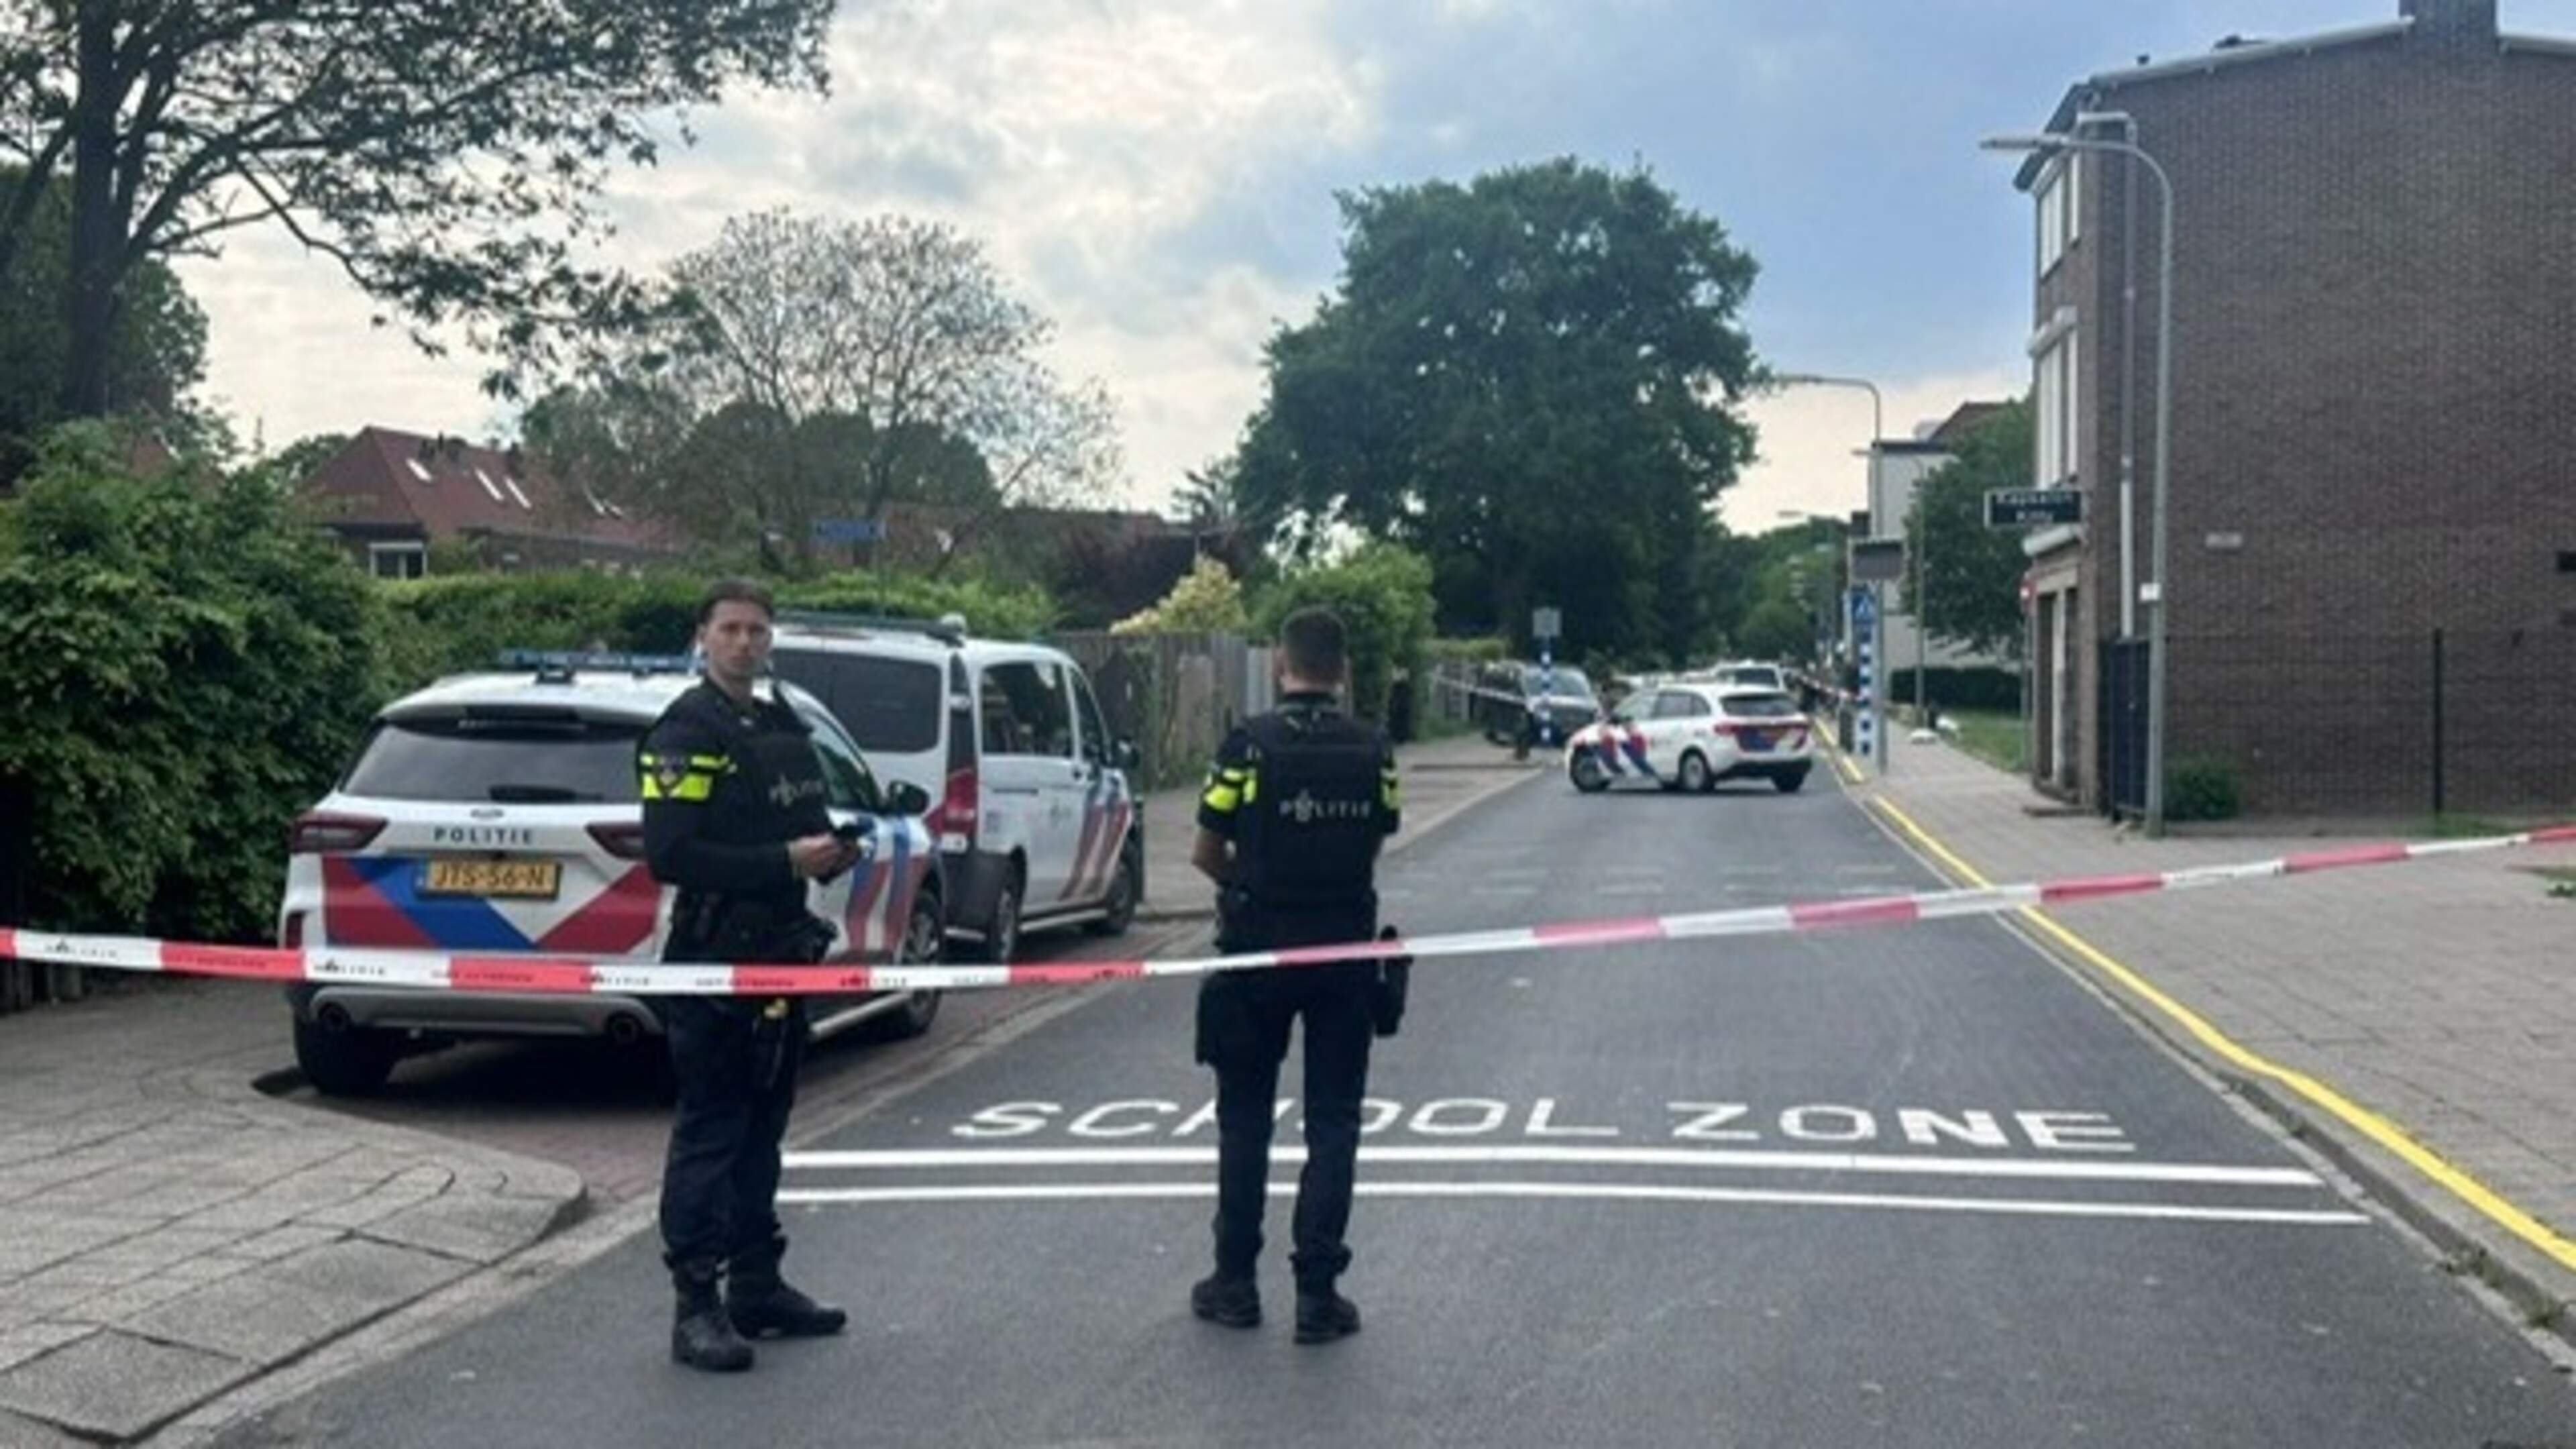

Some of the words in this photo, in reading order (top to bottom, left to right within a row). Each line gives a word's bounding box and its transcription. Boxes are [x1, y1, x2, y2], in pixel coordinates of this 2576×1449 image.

[433, 826, 533, 845] POLITIE
[433, 861, 545, 887] JTS-56-N
[1665, 1101, 2137, 1152] ZONE
